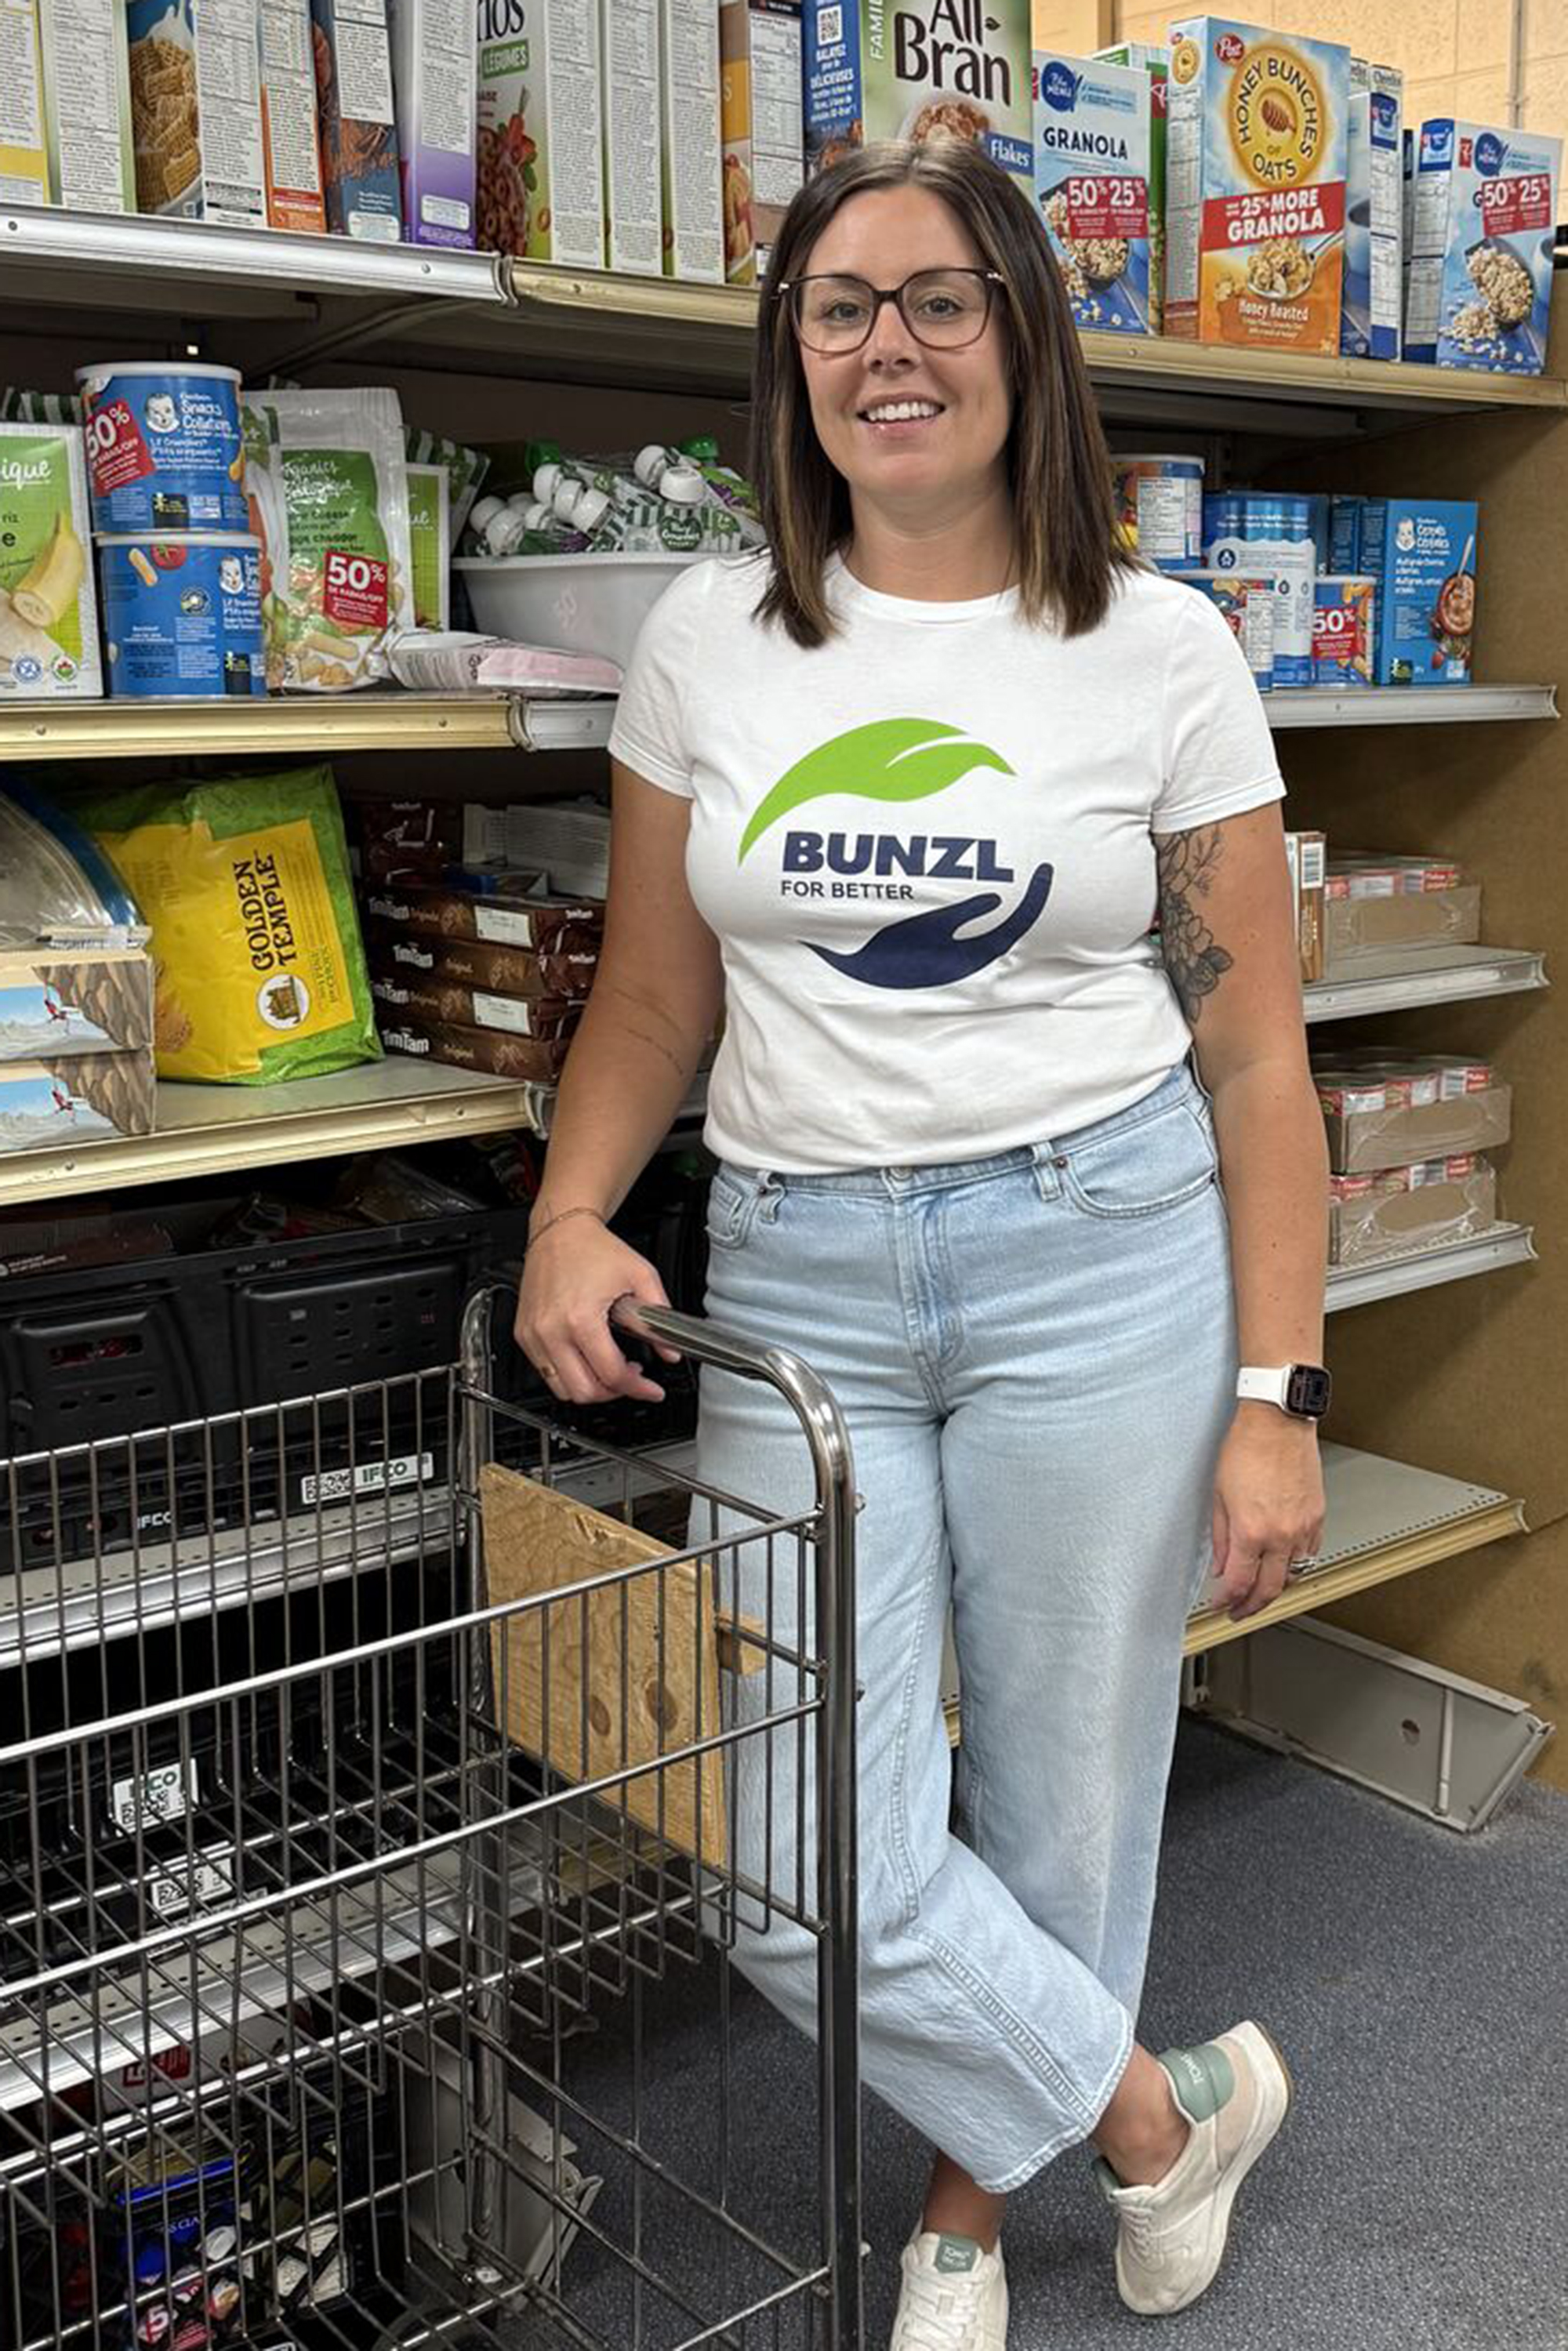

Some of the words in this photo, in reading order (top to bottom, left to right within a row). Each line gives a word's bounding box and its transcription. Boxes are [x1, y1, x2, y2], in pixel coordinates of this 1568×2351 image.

[895, 12, 1011, 107] Bran
[1236, 61, 1263, 144] HONEY
[1268, 58, 1318, 158] BUNCHES
[991, 139, 1030, 167] Flakes
[1044, 126, 1128, 160] GRANOLA
[1253, 153, 1297, 180] OATS
[1270, 188, 1319, 213] MORE
[1227, 208, 1325, 242] GRANOLA
[328, 555, 386, 591] 50%
[782, 831, 1014, 883] BUNZL
[254, 849, 298, 967] TEMPLE
[781, 880, 824, 898] FOR
[831, 883, 915, 901] BETTER
[232, 860, 274, 972] GOLDEN
